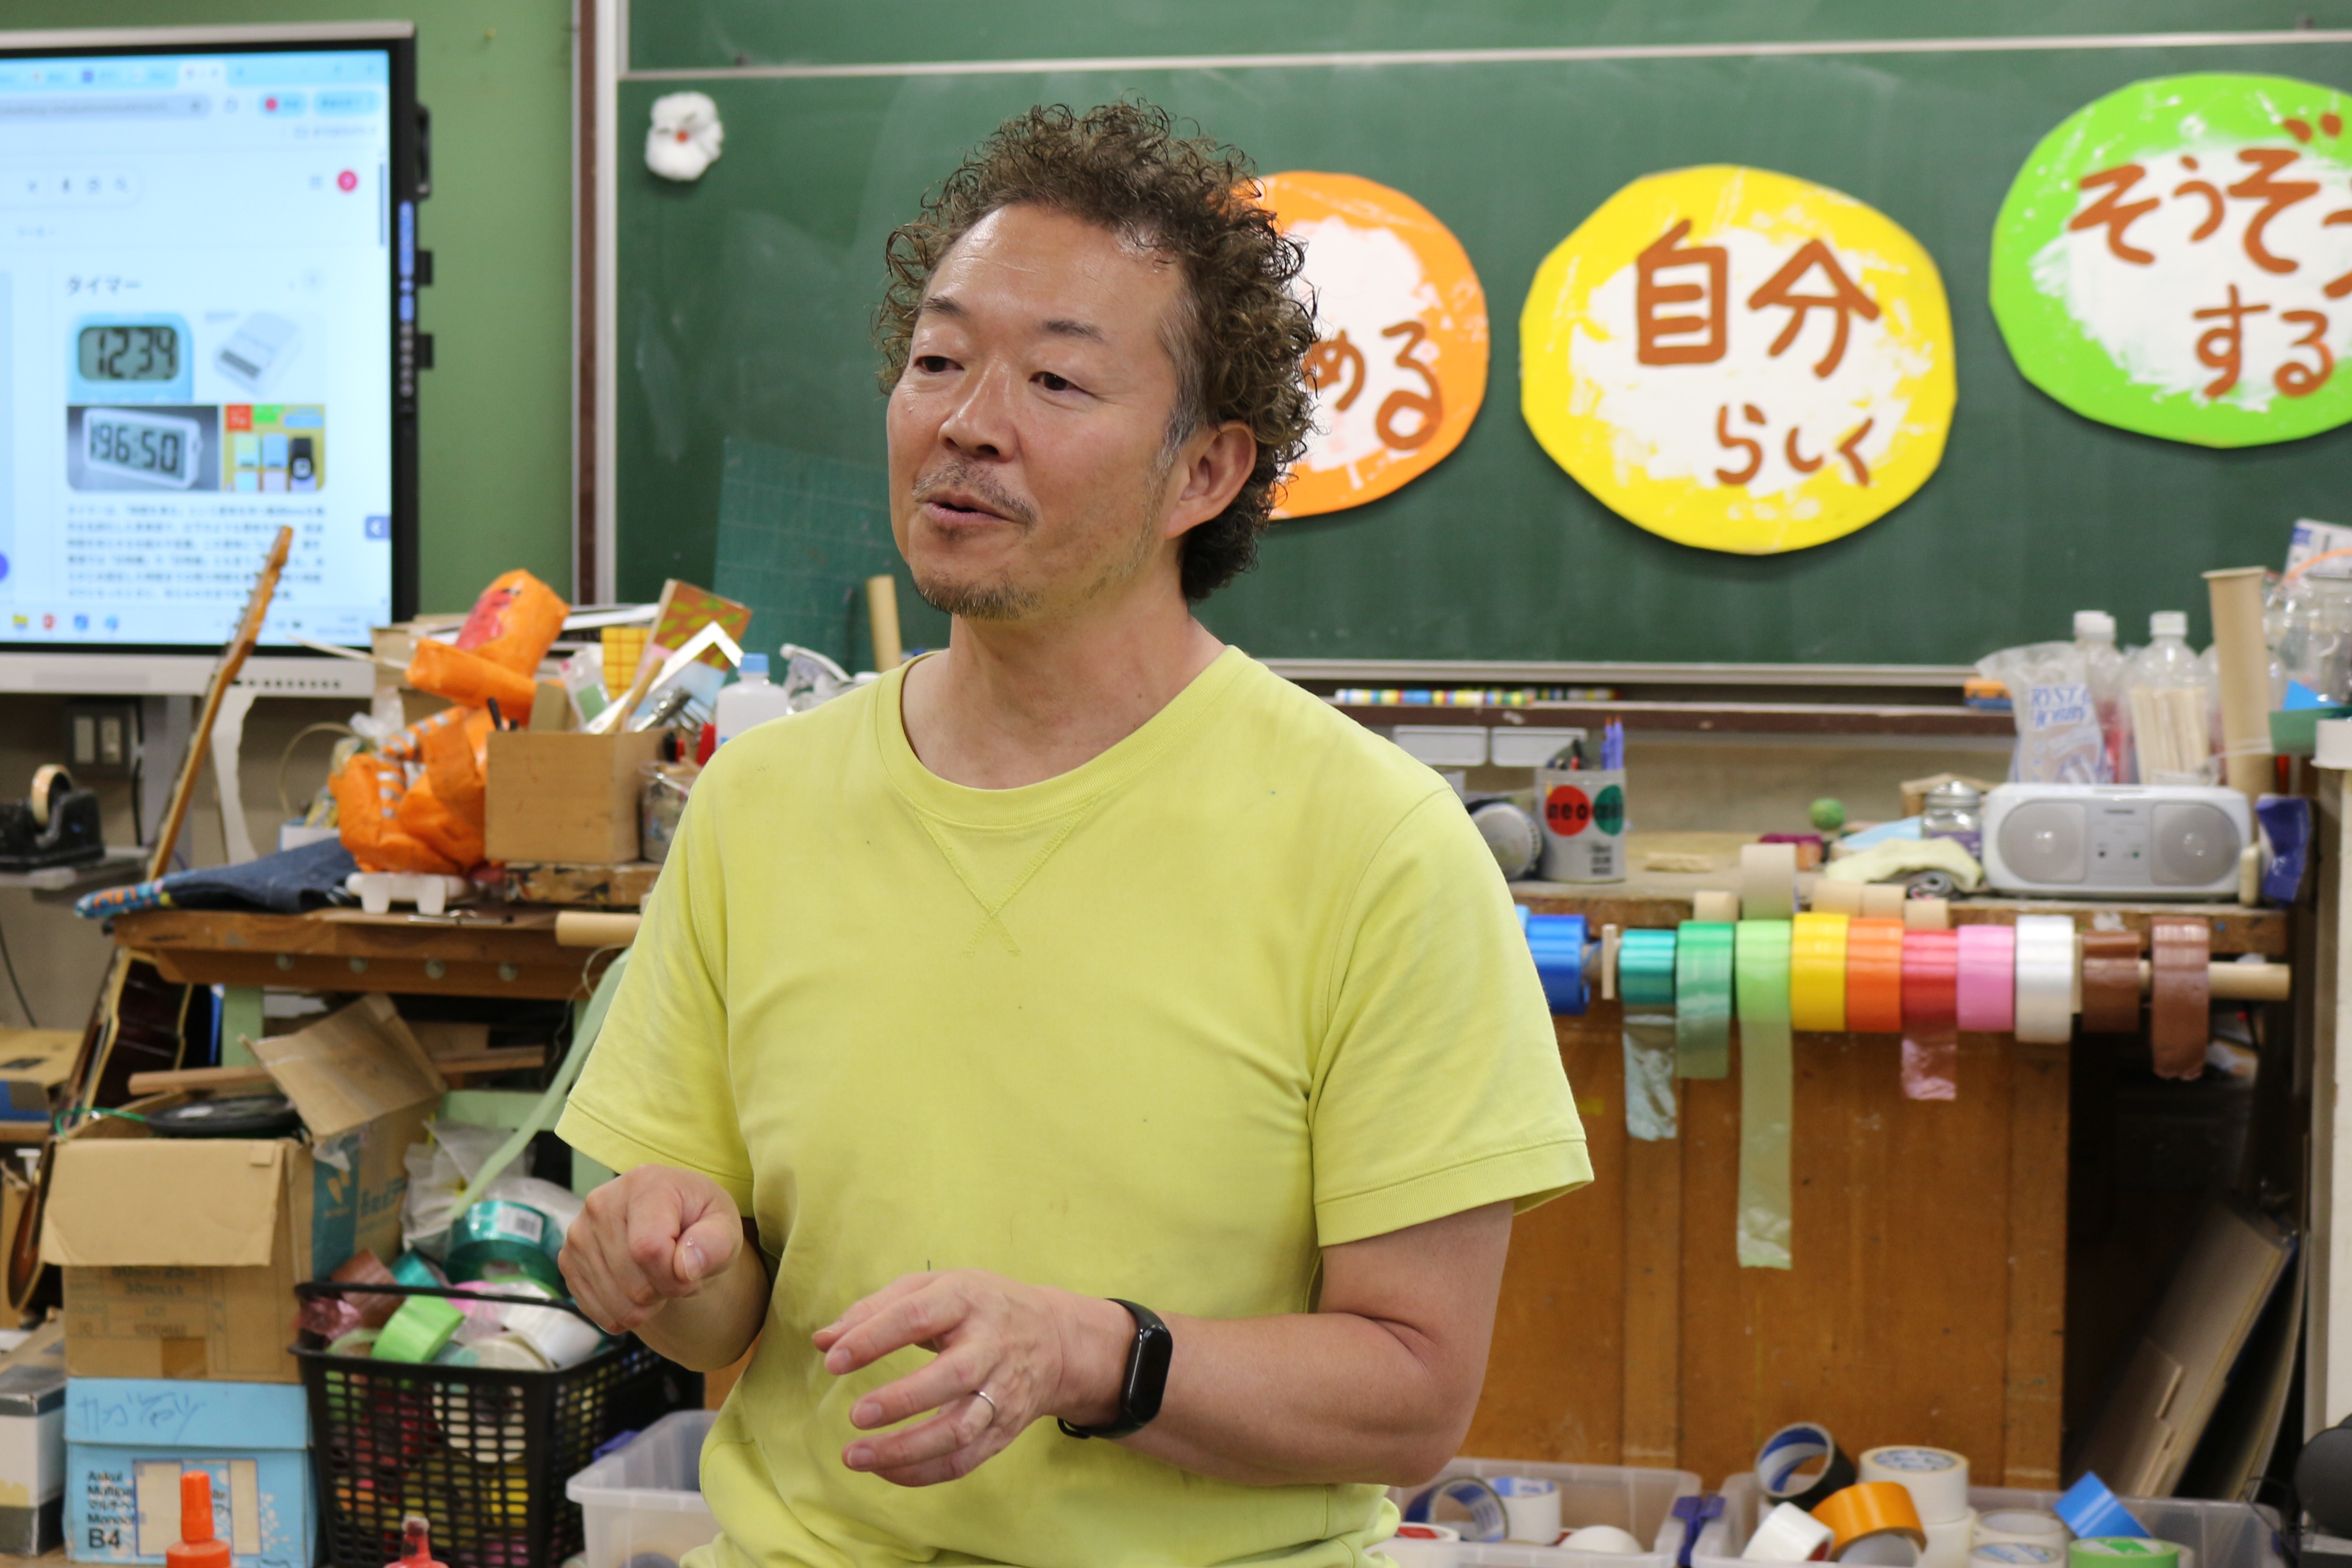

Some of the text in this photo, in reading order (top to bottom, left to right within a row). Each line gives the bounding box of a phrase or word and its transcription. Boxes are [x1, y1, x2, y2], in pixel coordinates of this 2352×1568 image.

[68, 276, 142, 296] タイマー
[1636, 217, 1881, 380] 自分
[97, 326, 176, 379] 1234
[2192, 283, 2336, 400] する
[1715, 403, 1875, 488] らしく
[89, 1528, 121, 1549] B4
